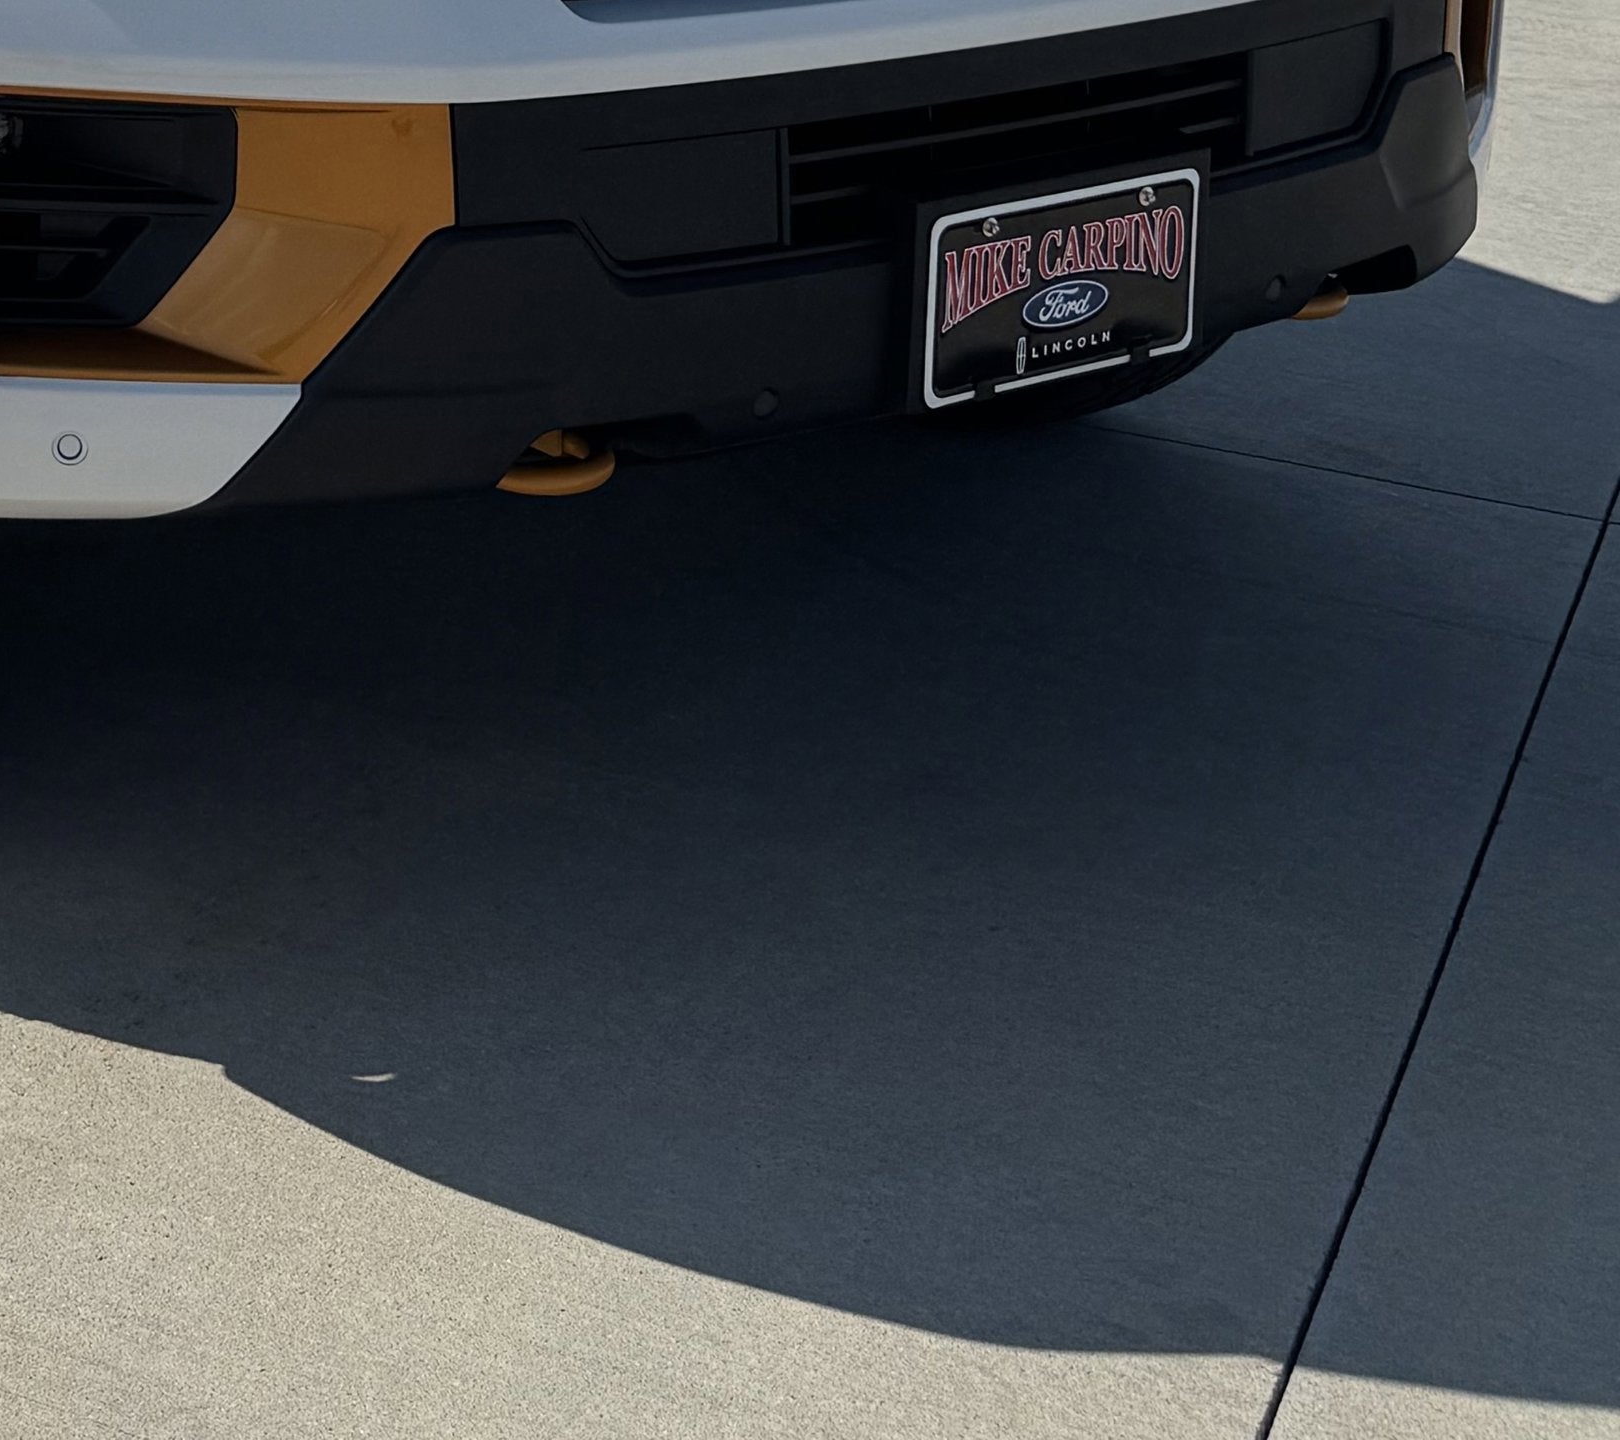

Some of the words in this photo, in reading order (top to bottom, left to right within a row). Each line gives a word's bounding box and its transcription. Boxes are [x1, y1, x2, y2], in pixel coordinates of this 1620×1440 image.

[941, 236, 1031, 334] MIKE
[1038, 205, 1184, 280] CARPINO
[1039, 288, 1090, 322] Ford
[1031, 330, 1111, 358] LINCOLN
